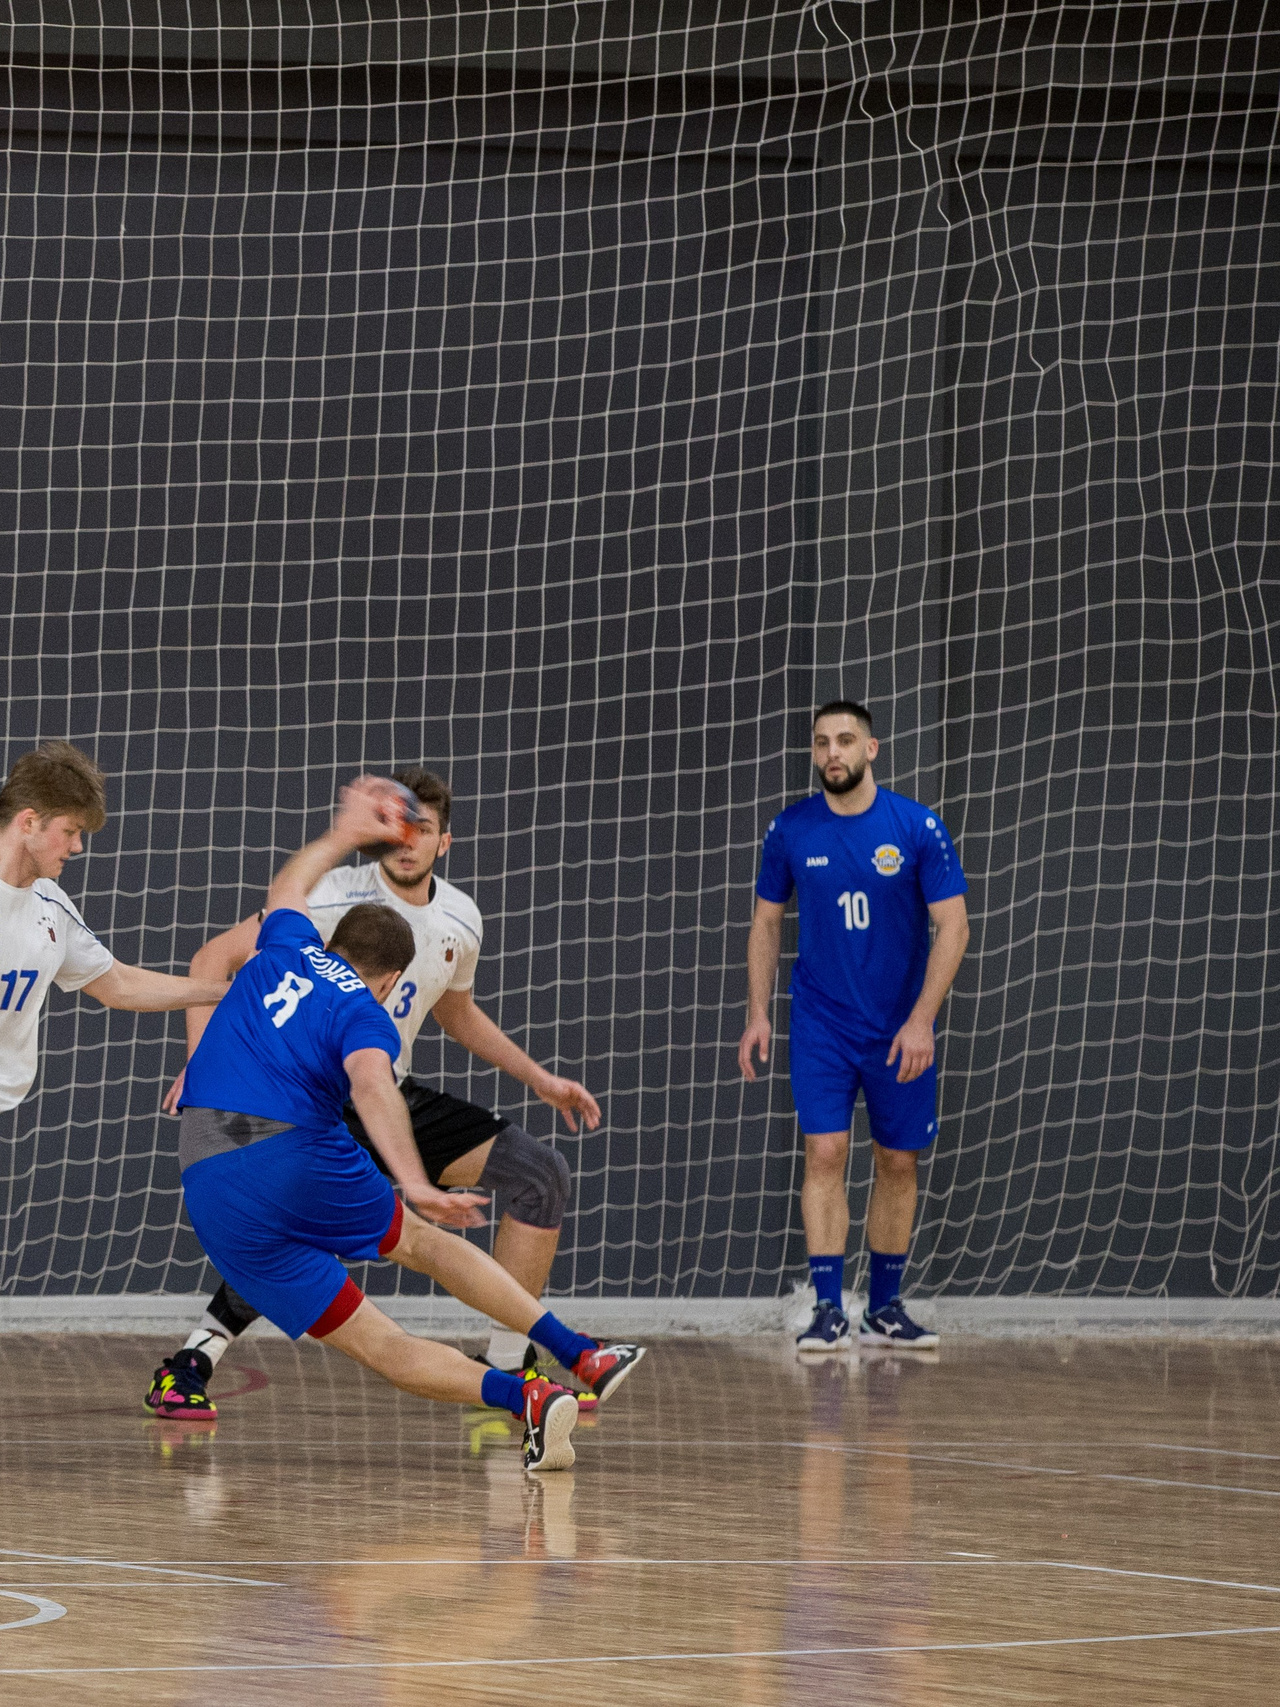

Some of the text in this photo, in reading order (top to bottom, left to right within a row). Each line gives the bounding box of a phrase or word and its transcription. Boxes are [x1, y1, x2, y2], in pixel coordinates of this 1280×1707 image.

[837, 891, 870, 931] 10
[0, 969, 39, 1012] 17
[393, 981, 417, 1019] 3
